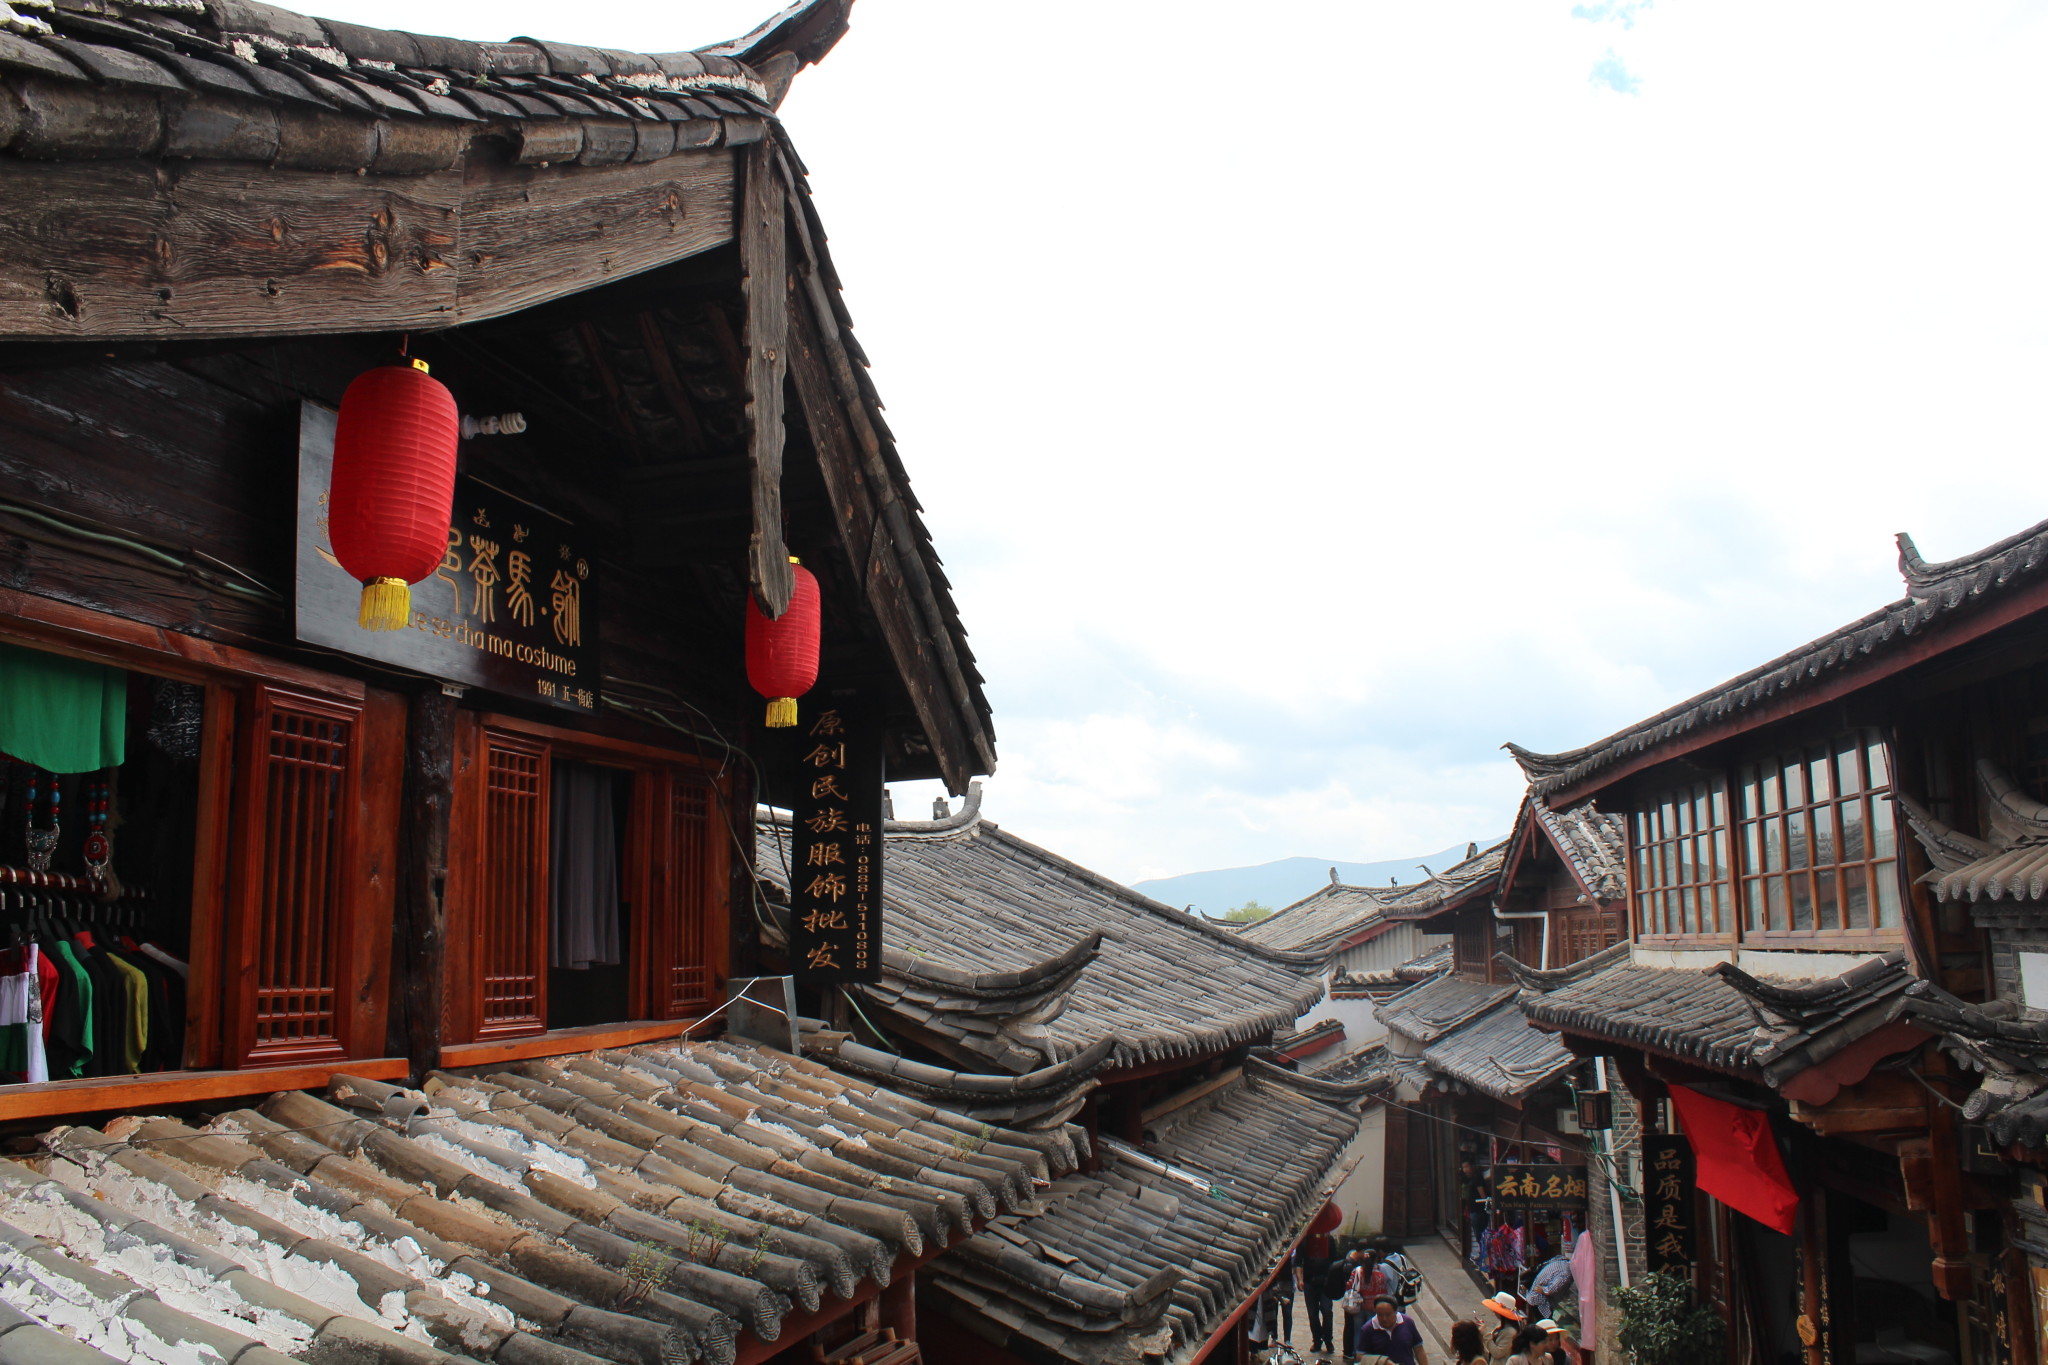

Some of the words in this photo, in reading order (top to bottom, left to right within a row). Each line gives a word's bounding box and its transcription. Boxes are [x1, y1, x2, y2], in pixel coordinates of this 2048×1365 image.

[432, 616, 452, 639] se
[455, 619, 485, 651] cha
[488, 633, 513, 659] ma
[516, 642, 577, 677] costume
[537, 678, 557, 698] 1991
[562, 685, 594, 709] 五一街店
[800, 708, 849, 970] 原创民族服饰批发
[1495, 1172, 1586, 1199] 云南名烟
